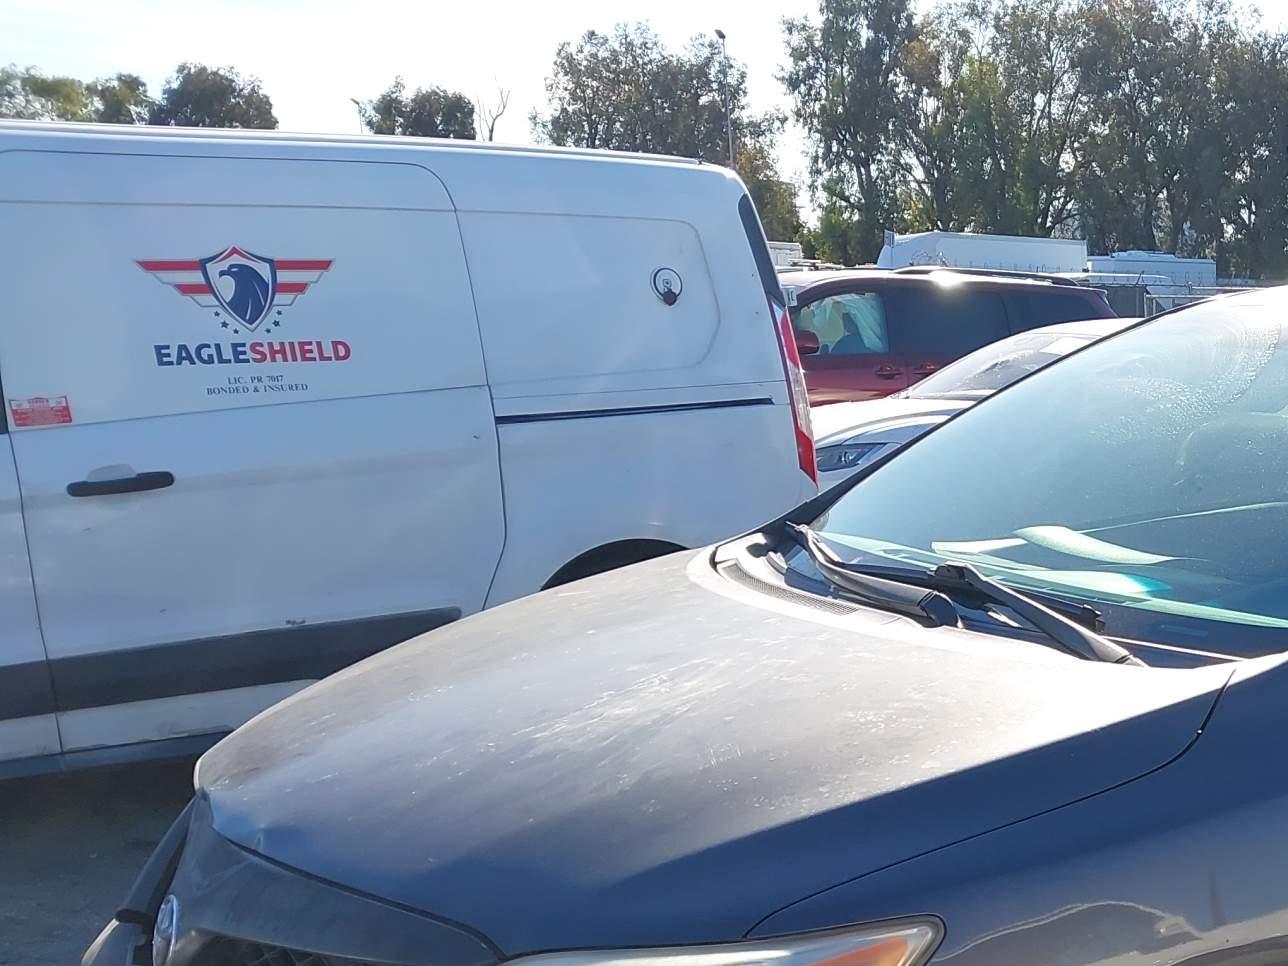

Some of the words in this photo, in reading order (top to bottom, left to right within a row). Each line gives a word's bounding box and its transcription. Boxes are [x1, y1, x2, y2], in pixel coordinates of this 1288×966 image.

[153, 340, 351, 367] EAGLESHIELD
[227, 376, 247, 385] LIC.
[250, 375, 263, 384] PR
[207, 385, 249, 395] BONDED
[253, 385, 260, 393] &
[264, 383, 308, 393] INSURED
